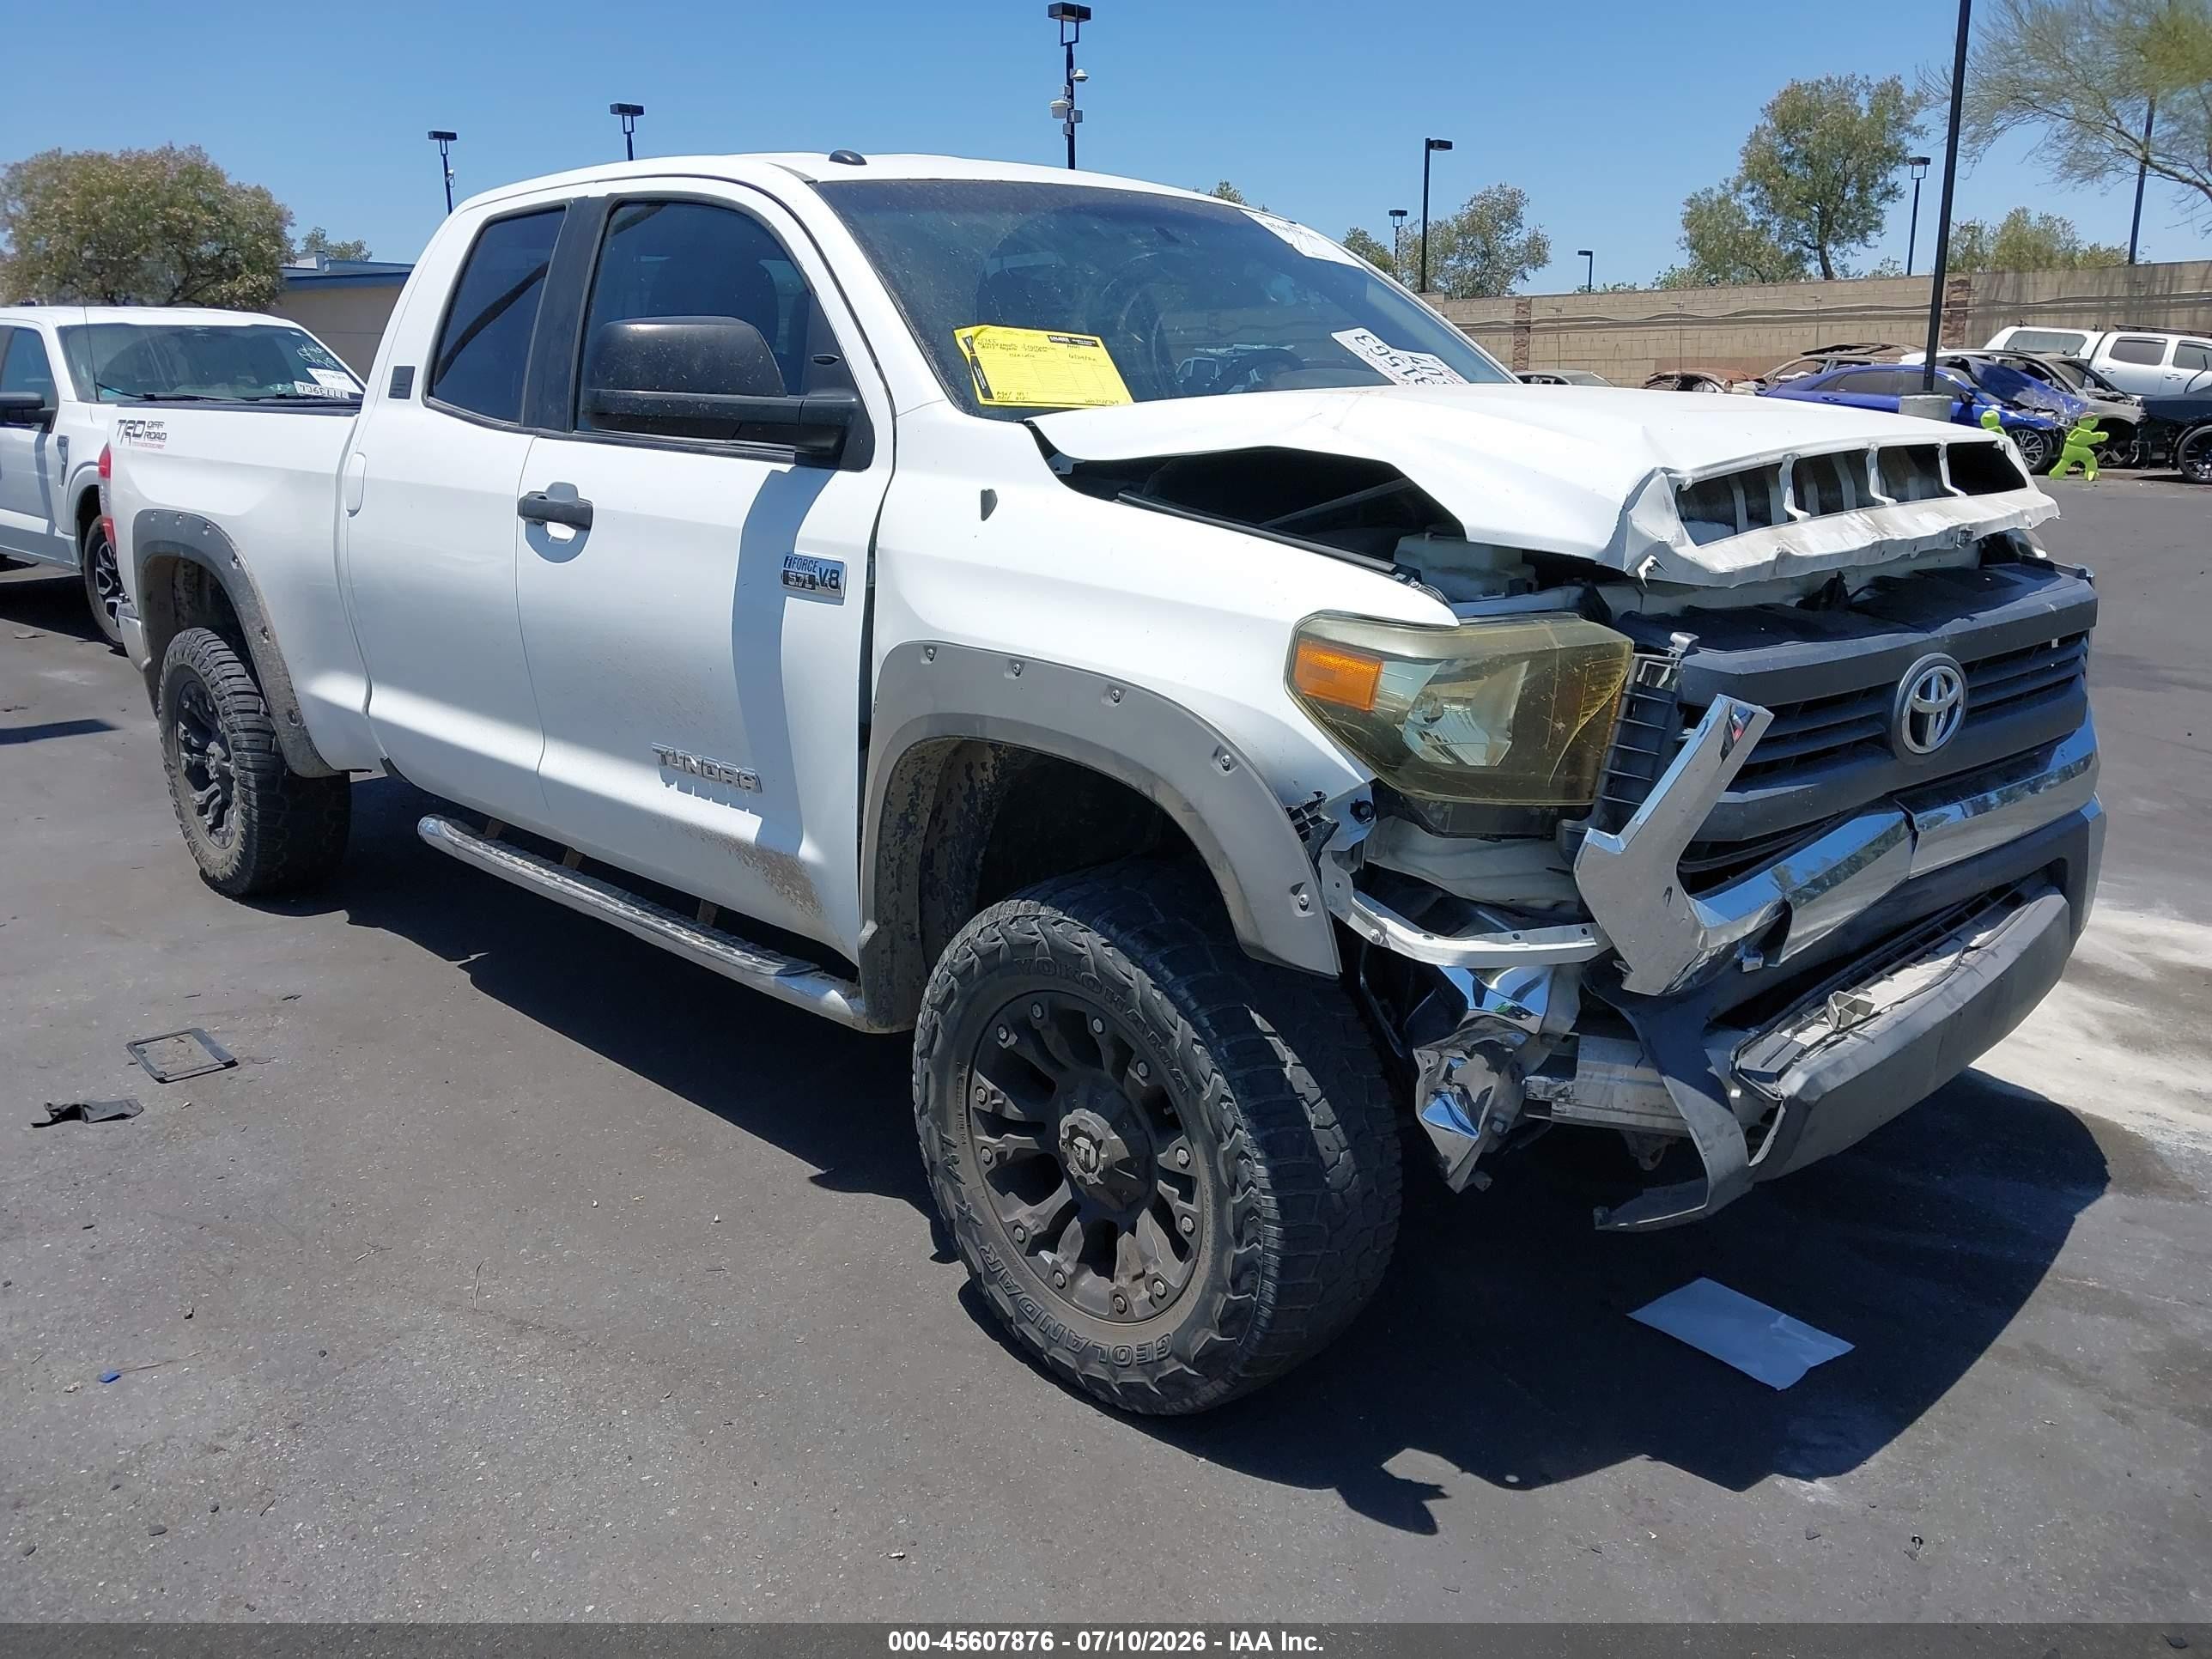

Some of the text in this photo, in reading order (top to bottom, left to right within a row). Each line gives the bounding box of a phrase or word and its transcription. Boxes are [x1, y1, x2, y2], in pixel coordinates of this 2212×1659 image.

[117, 419, 146, 447] TRD
[143, 431, 167, 442] ROAD
[818, 566, 840, 590] V8
[651, 742, 763, 793] TUNDRA
[1013, 956, 1189, 1095] YOKOHAMA
[979, 1242, 1174, 1368] GEOLANDAR
